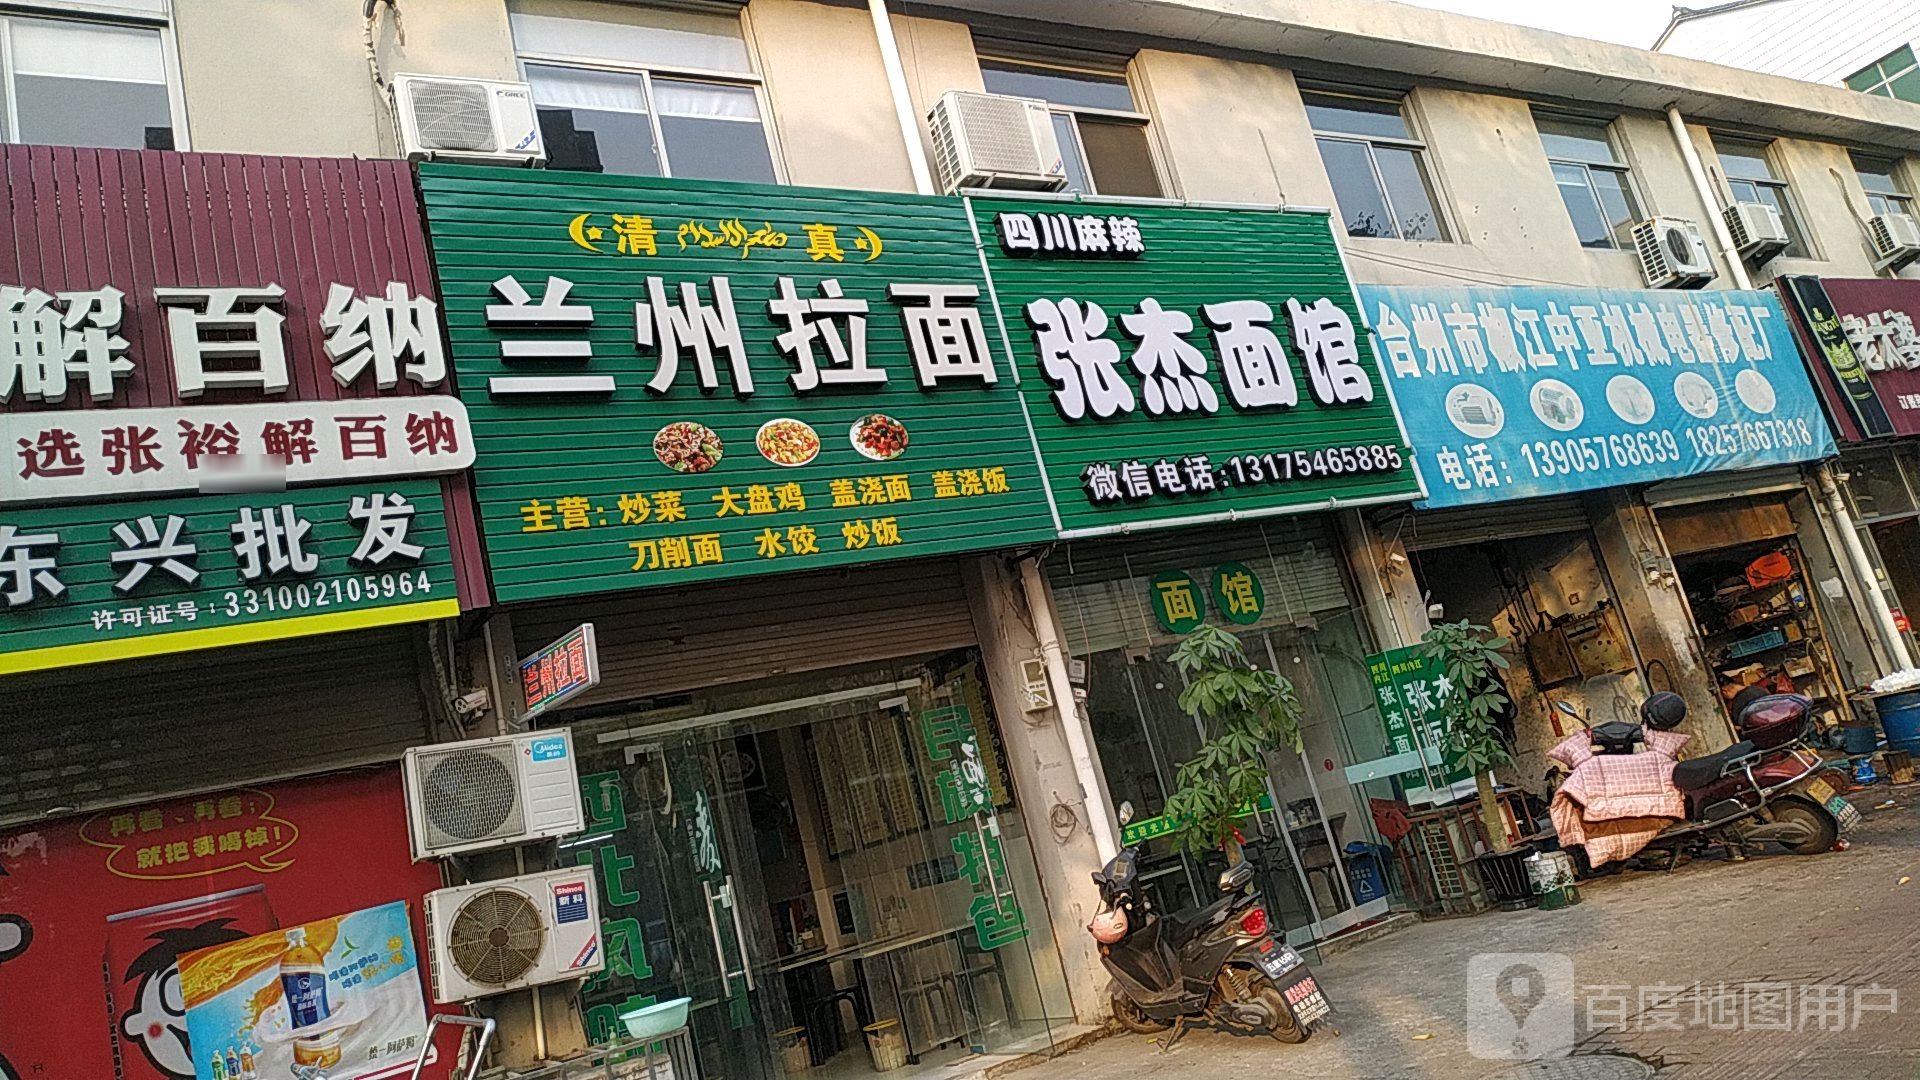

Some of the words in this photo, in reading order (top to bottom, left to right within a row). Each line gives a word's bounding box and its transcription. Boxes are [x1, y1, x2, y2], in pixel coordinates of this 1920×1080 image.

[612, 214, 657, 256] 清
[806, 223, 845, 262] 真
[998, 212, 1145, 254] 四川麻辣
[0, 281, 448, 401] 解百纳
[485, 275, 999, 398] 兰州拉面
[1026, 297, 1374, 419] 张杰面馆
[18, 410, 459, 481] 选张裕解百纳
[1686, 416, 1813, 461] 18257667318
[712, 481, 807, 519] 大盘鸡
[829, 473, 912, 509] 盖浇面
[932, 466, 1010, 497] 盖浇饭
[0, 492, 425, 606] 东兴批发
[628, 532, 723, 572] 刀削面
[754, 526, 819, 561] 水饺
[843, 517, 903, 551] 炒饭
[1157, 571, 1259, 624] 面馆
[556, 886, 583, 895] Shinco
[558, 894, 584, 906] 新科
